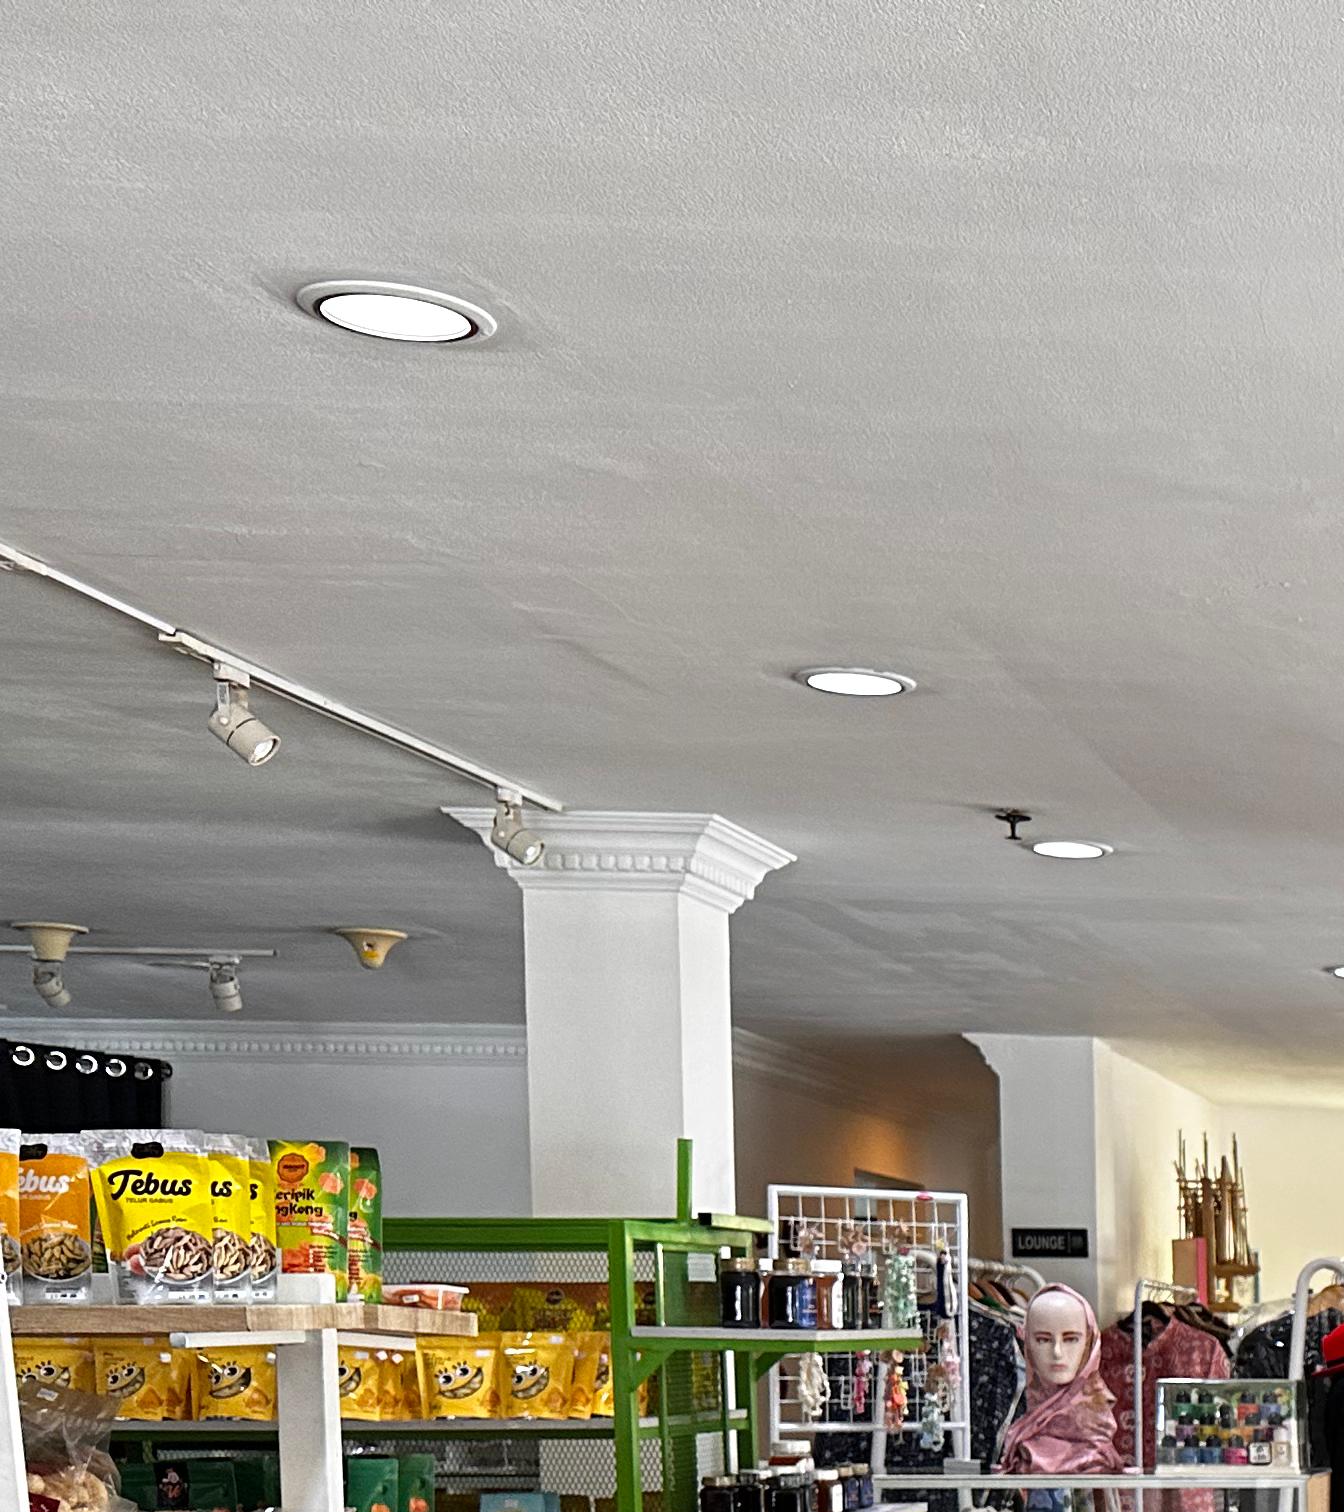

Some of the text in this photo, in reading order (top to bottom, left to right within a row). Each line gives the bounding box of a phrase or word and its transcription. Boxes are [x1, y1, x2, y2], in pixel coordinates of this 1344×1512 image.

[21, 1167, 71, 1193] ebus
[108, 1169, 192, 1201] Tebus
[275, 1188, 315, 1203] eripik
[1019, 1235, 1066, 1250] LOUNGE
